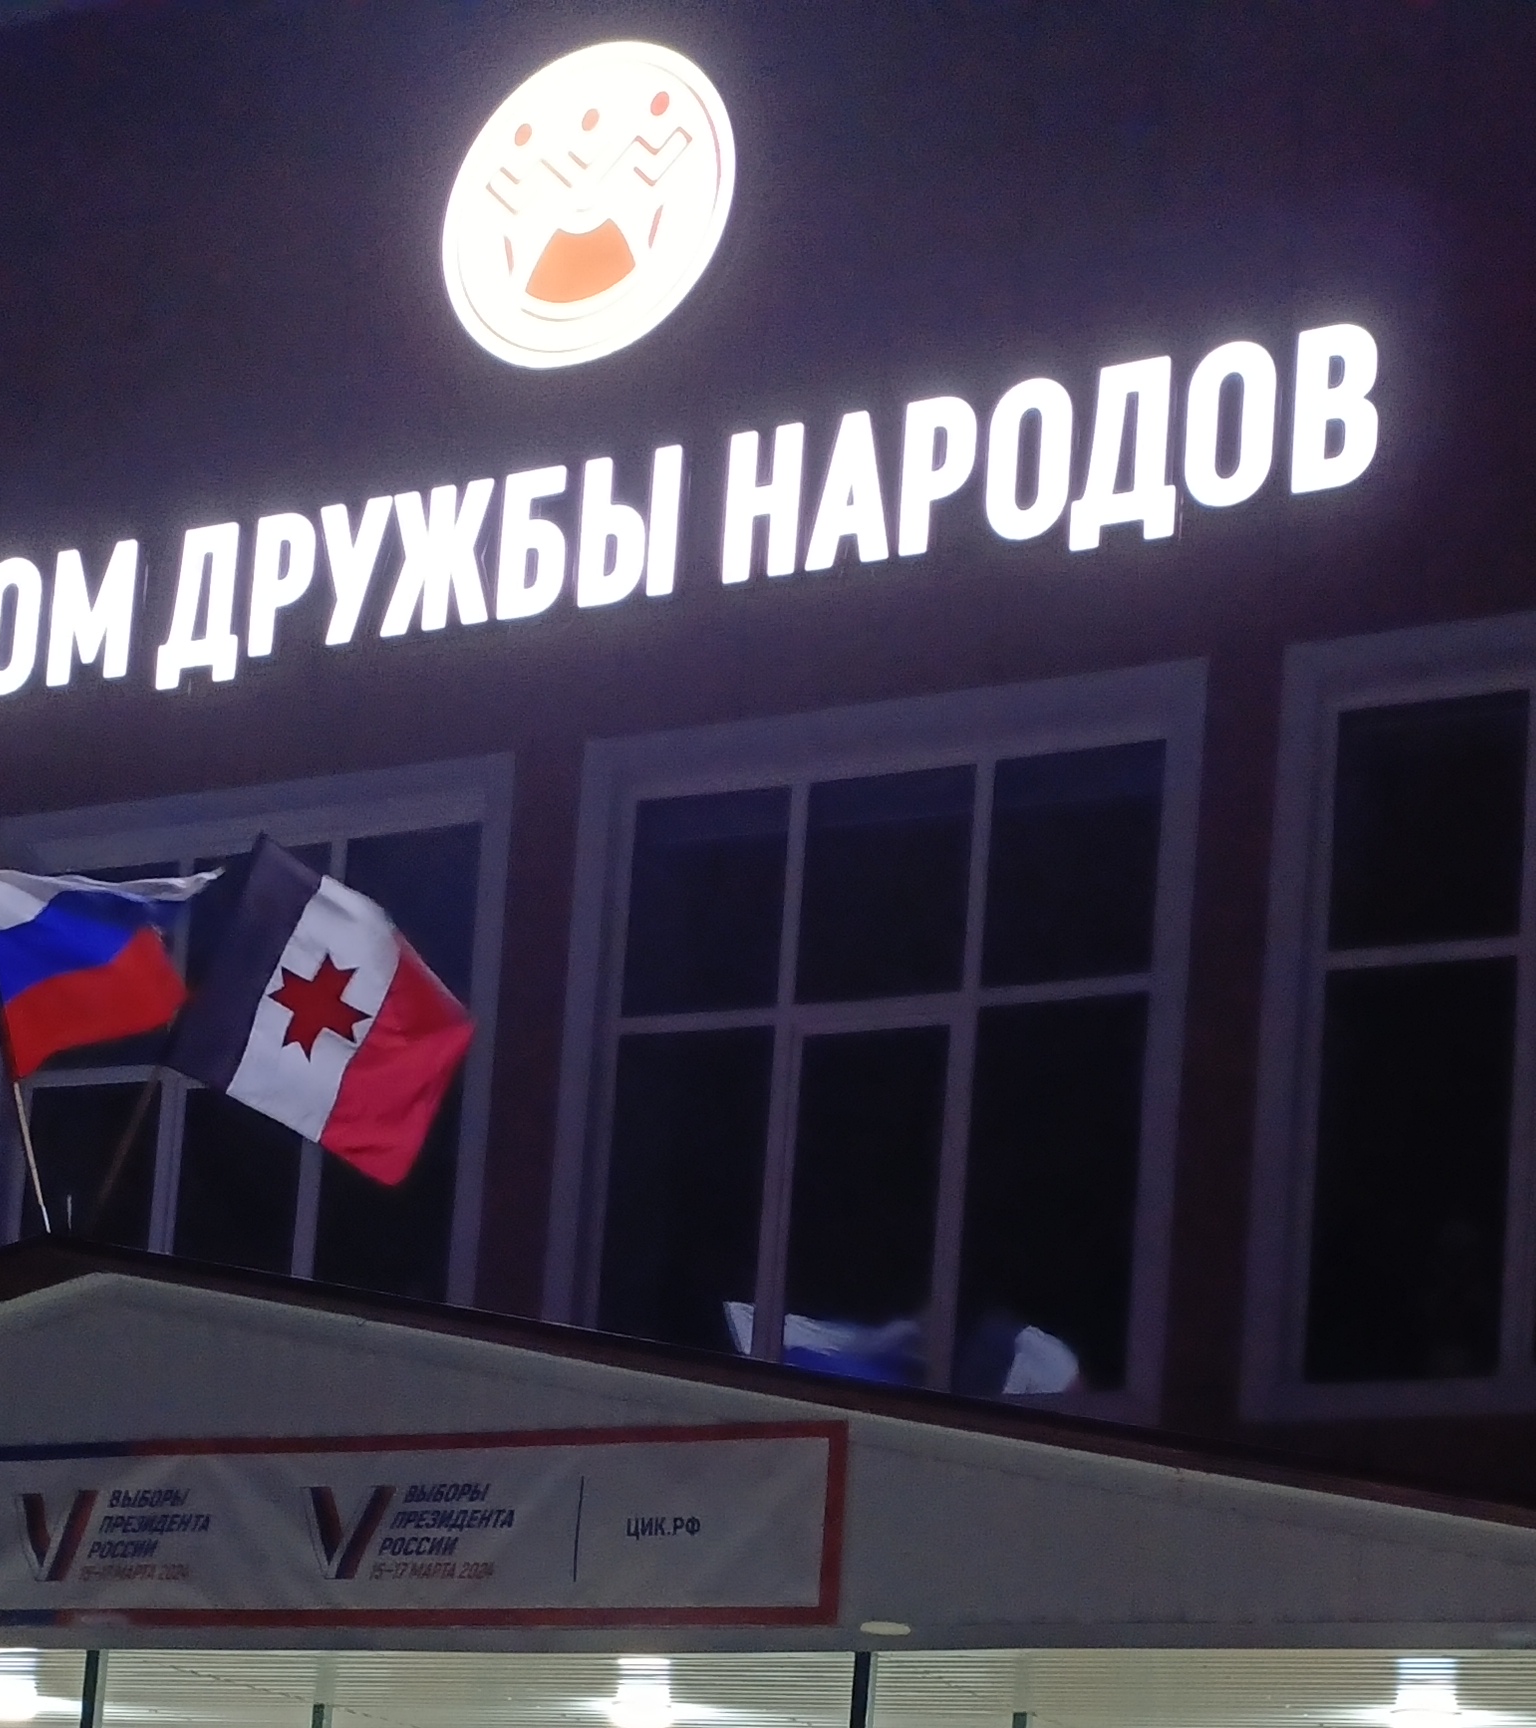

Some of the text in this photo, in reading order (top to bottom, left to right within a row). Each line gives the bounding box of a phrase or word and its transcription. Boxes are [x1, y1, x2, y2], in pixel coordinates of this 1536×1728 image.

[154, 444, 684, 691] ДРУЖБЫ
[721, 322, 1380, 586] НАРОДОВ
[108, 1488, 190, 1508] ВЫБОРЫ
[403, 1483, 491, 1504] ВЫБОРЫ
[99, 1513, 211, 1535] ПРЕЗИДЕНТА
[389, 1509, 515, 1532] ПРЕЗИДЕНТА
[626, 1516, 701, 1541] ЦИК.РФ
[87, 1539, 158, 1559] РОССИИ
[378, 1536, 459, 1556] РОССИИ
[408, 1562, 456, 1580] МАРТА
[458, 1562, 493, 1579] 2024
